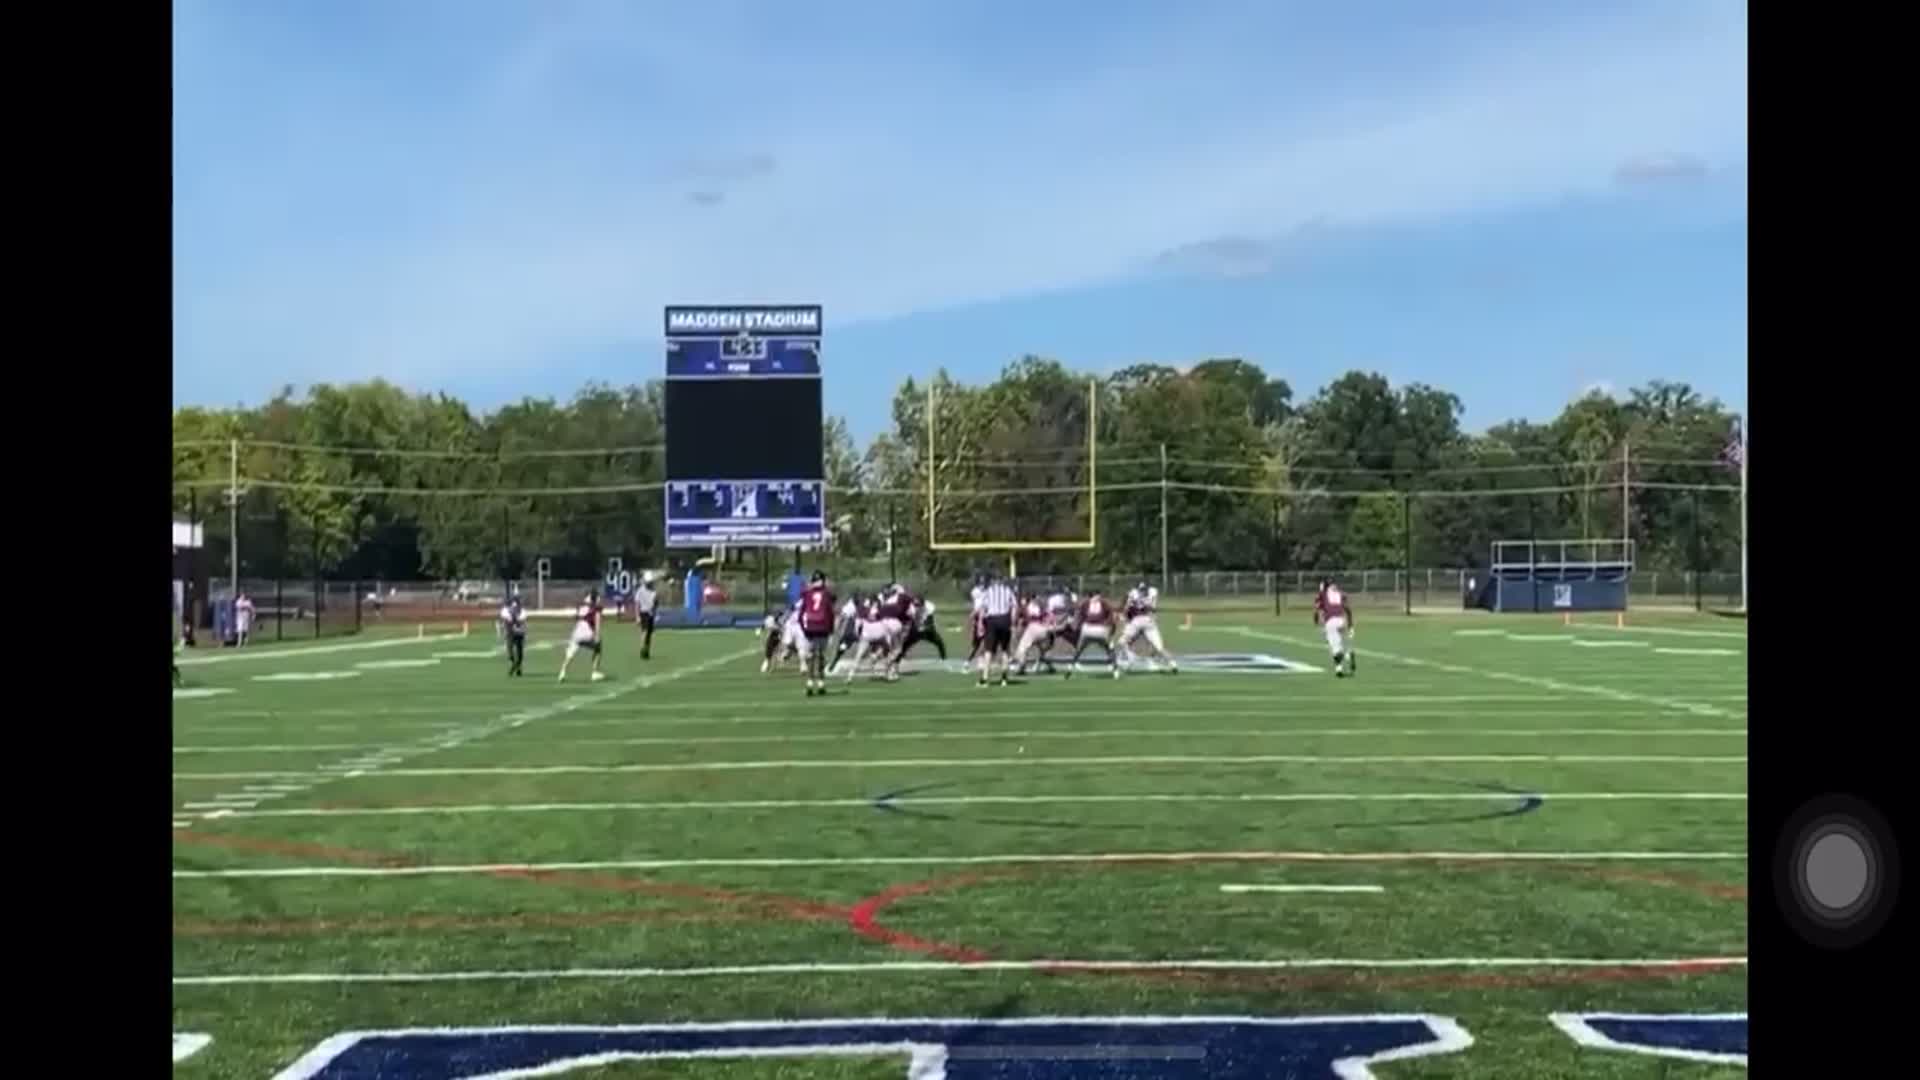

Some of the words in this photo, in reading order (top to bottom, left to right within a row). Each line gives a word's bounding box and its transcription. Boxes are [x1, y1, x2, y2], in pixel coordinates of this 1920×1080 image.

[669, 312, 741, 328] MADDEN
[744, 311, 817, 328] STADIUM
[605, 569, 631, 594] 40
[811, 591, 824, 611] 7
